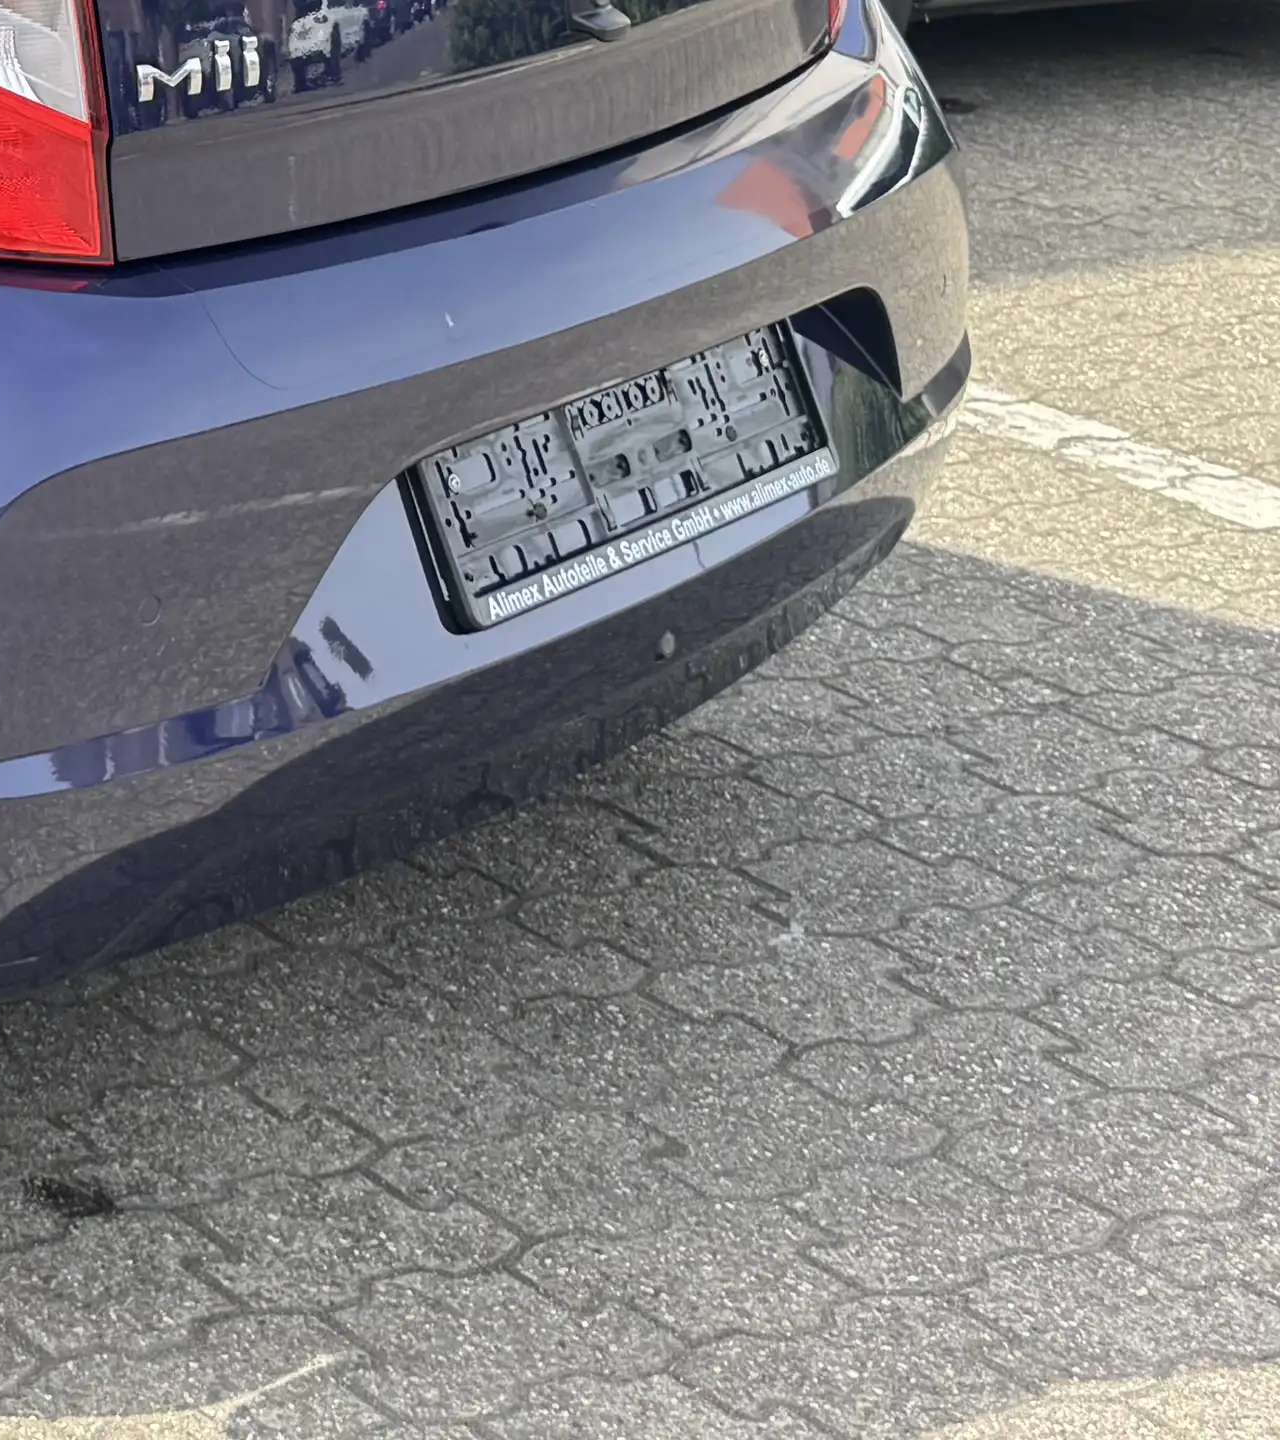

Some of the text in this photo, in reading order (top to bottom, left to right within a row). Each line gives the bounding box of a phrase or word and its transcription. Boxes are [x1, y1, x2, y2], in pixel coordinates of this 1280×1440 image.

[136, 36, 261, 103] Mii
[487, 456, 832, 621] Alimex Autoteile & Service GmbH www.alimex-auto.de
